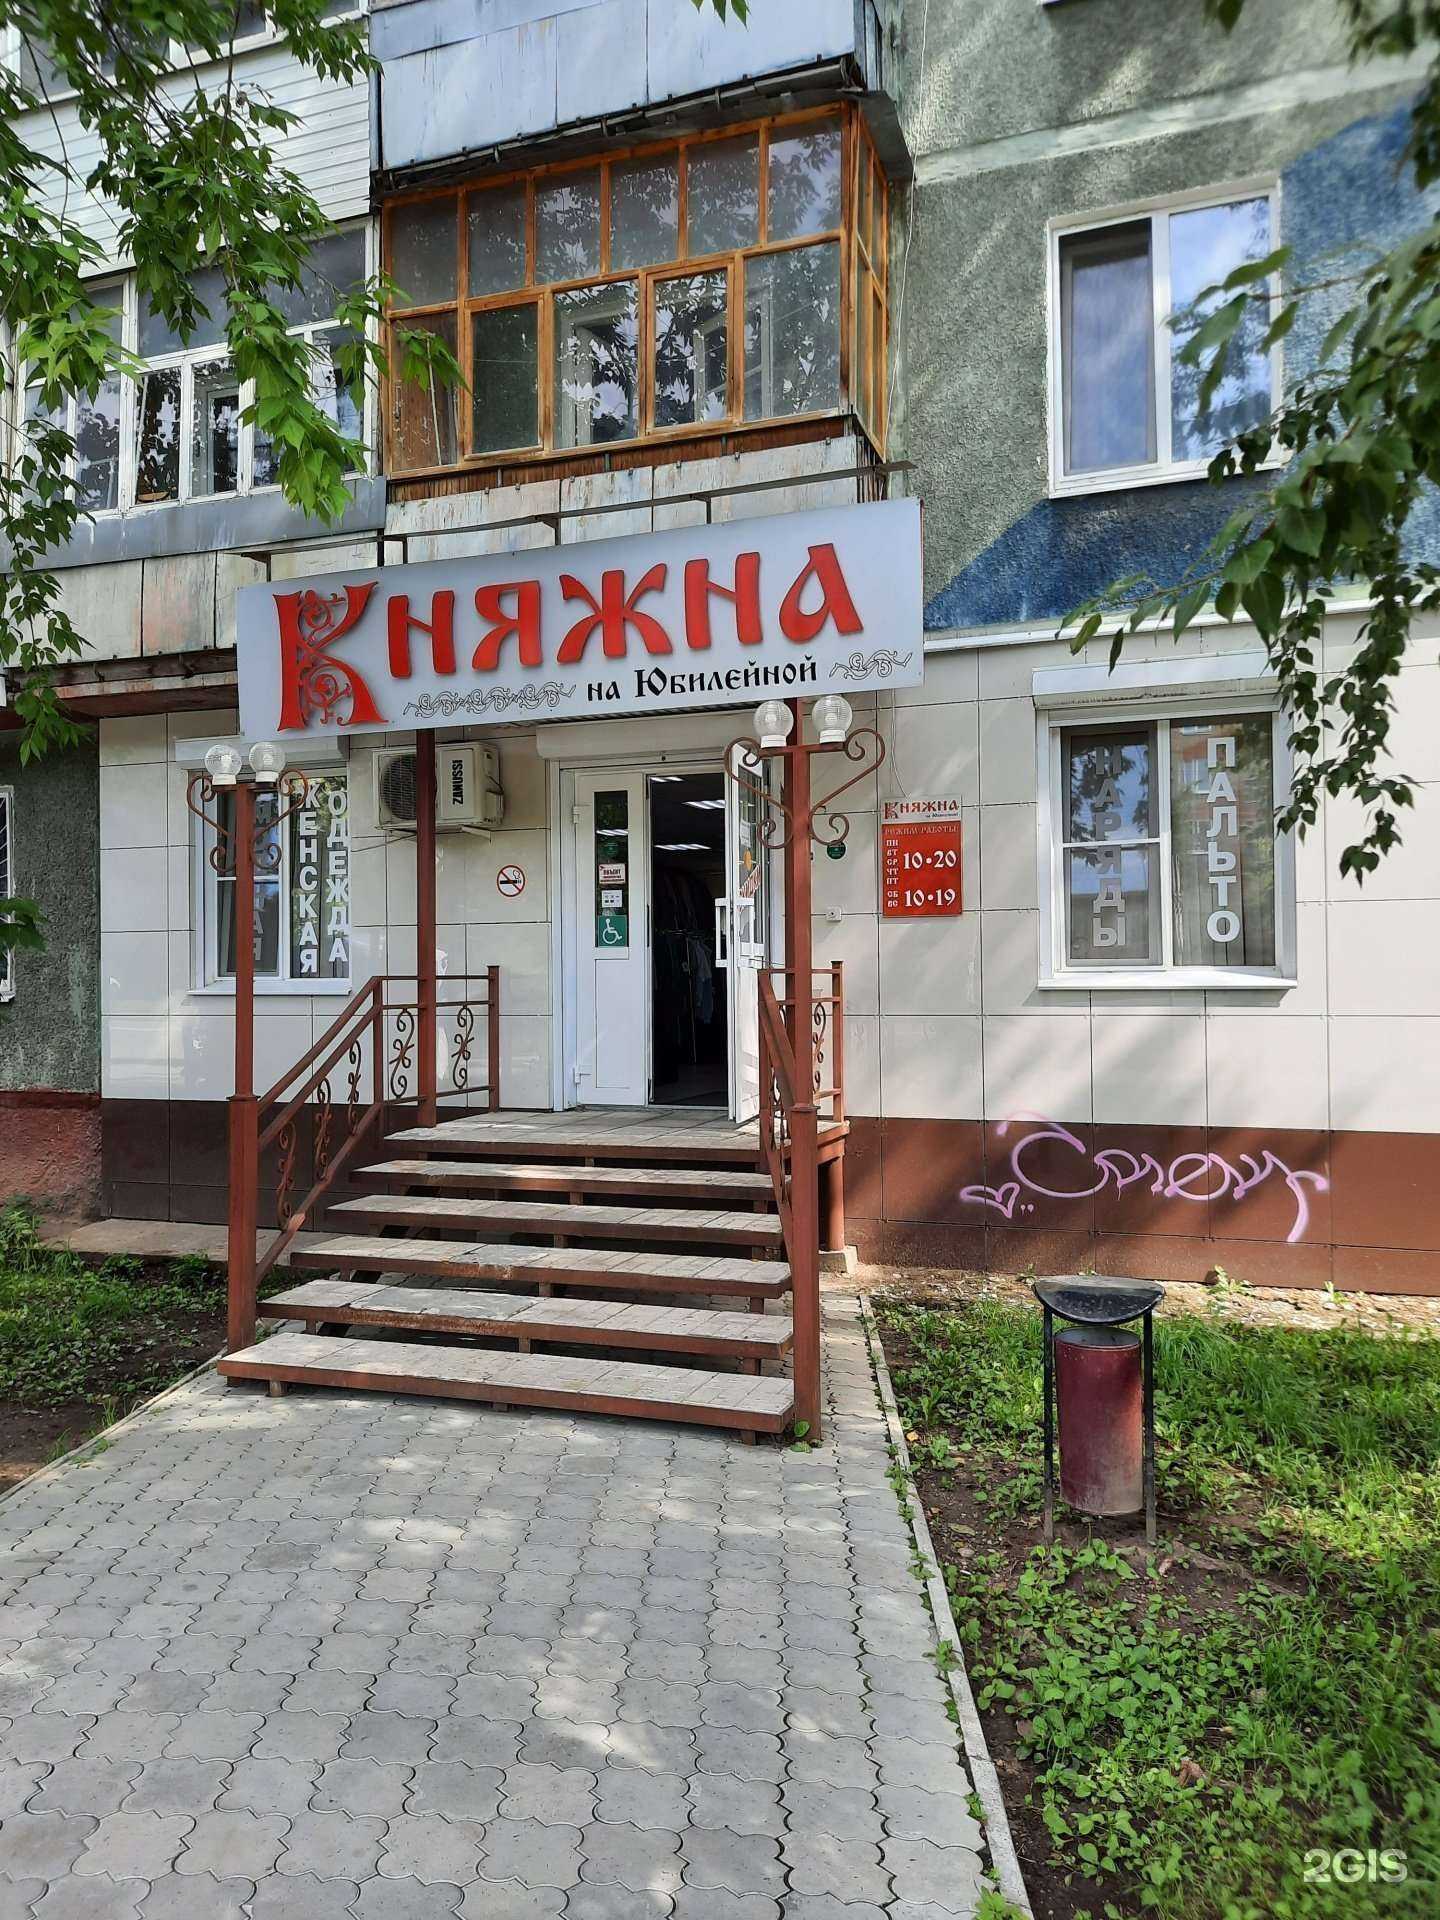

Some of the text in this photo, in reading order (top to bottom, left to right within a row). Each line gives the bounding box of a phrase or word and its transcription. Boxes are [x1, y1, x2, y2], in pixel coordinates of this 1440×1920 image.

[272, 542, 864, 732] Княжна
[588, 655, 817, 701] на Юбилейной
[326, 790, 349, 962] ОДЕЖДА
[452, 759, 464, 805] ZANUSSI
[1093, 744, 1126, 947] НАРЯДЫ
[1206, 736, 1241, 943] ПАЛЬТО
[297, 783, 321, 973] ЖЕНСКАЯ
